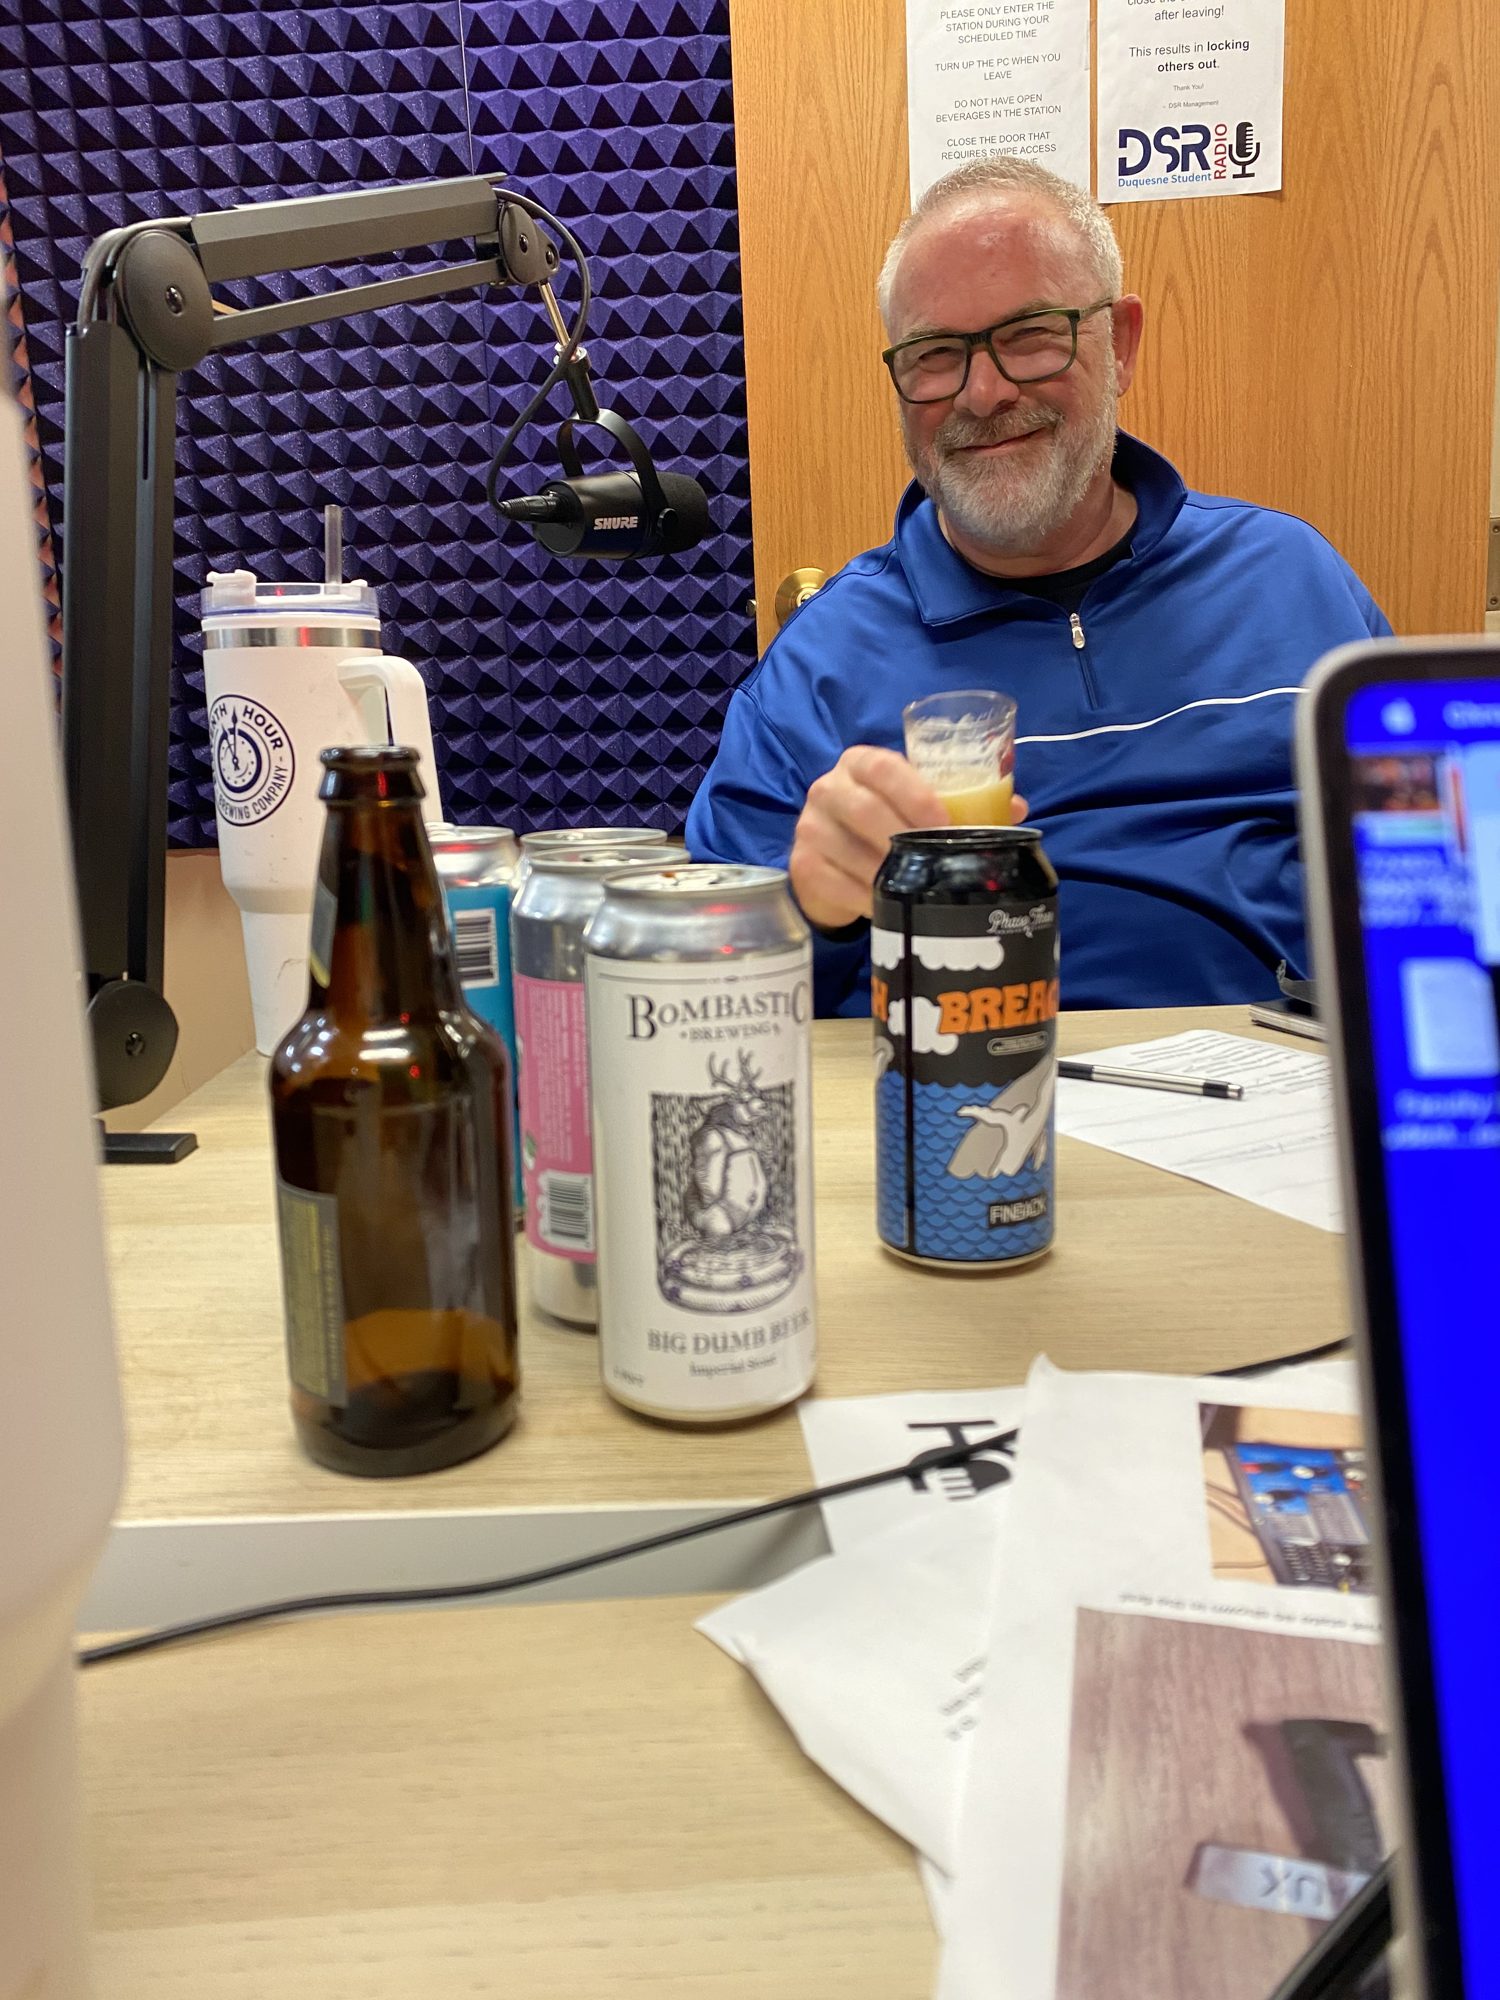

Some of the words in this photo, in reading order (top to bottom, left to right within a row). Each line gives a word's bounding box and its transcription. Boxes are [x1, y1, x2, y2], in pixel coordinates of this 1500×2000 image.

[940, 9, 975, 19] PLEASE
[977, 6, 1001, 16] ONLY
[1003, 3, 1034, 14] ENTER
[1036, 1, 1055, 11] THE
[1154, 9, 1179, 21] after
[1182, 5, 1225, 19] leaving!
[945, 21, 983, 32] STATION
[985, 17, 1021, 29] DURING
[1023, 14, 1050, 25] YOUR
[958, 31, 1014, 44] SCHEDULED
[1016, 29, 1038, 39] TIME
[1129, 46, 1152, 57] This
[1155, 43, 1191, 55] results
[1194, 42, 1204, 53] in
[1207, 39, 1250, 52] locking
[935, 62, 960, 72] TURN
[962, 60, 975, 70] UP
[977, 58, 994, 68] THE
[996, 57, 1010, 67] PC
[1011, 55, 1039, 65] WHEN
[1041, 52, 1061, 62] YOU
[1157, 61, 1194, 72] others
[983, 70, 1012, 81] LEAVE
[954, 99, 968, 109] DO
[970, 98, 988, 107] NOT
[991, 95, 1015, 106] HAVE
[1017, 93, 1043, 104] OPEN
[1182, 100, 1219, 108] Management
[935, 111, 990, 123] BEVERAGES
[993, 110, 1002, 119] IN
[1003, 108, 1022, 117] THE
[1024, 105, 1062, 116] STATION
[946, 137, 977, 147] CLOSE
[979, 135, 997, 145] THE
[999, 133, 1026, 144] DOOR
[1028, 131, 1050, 141] THAT
[941, 149, 987, 160] REQUIRES
[989, 146, 1018, 157] SWIPE
[1019, 144, 1057, 155] ACCESS
[1118, 124, 1211, 176] DSR
[1213, 123, 1228, 180] RADIO
[1118, 176, 1169, 188] Duquesne
[1171, 173, 1212, 184] Student
[593, 516, 639, 530] SHURE
[242, 705, 284, 750] HOUR
[218, 794, 251, 820] BREWING
[252, 765, 288, 815] COMPANY
[626, 980, 809, 1041] BOMBASTIC
[688, 1021, 772, 1043] BREWING
[647, 1328, 687, 1354] BIG
[693, 1325, 767, 1355] DUMB
[690, 1358, 745, 1380] Imperial
